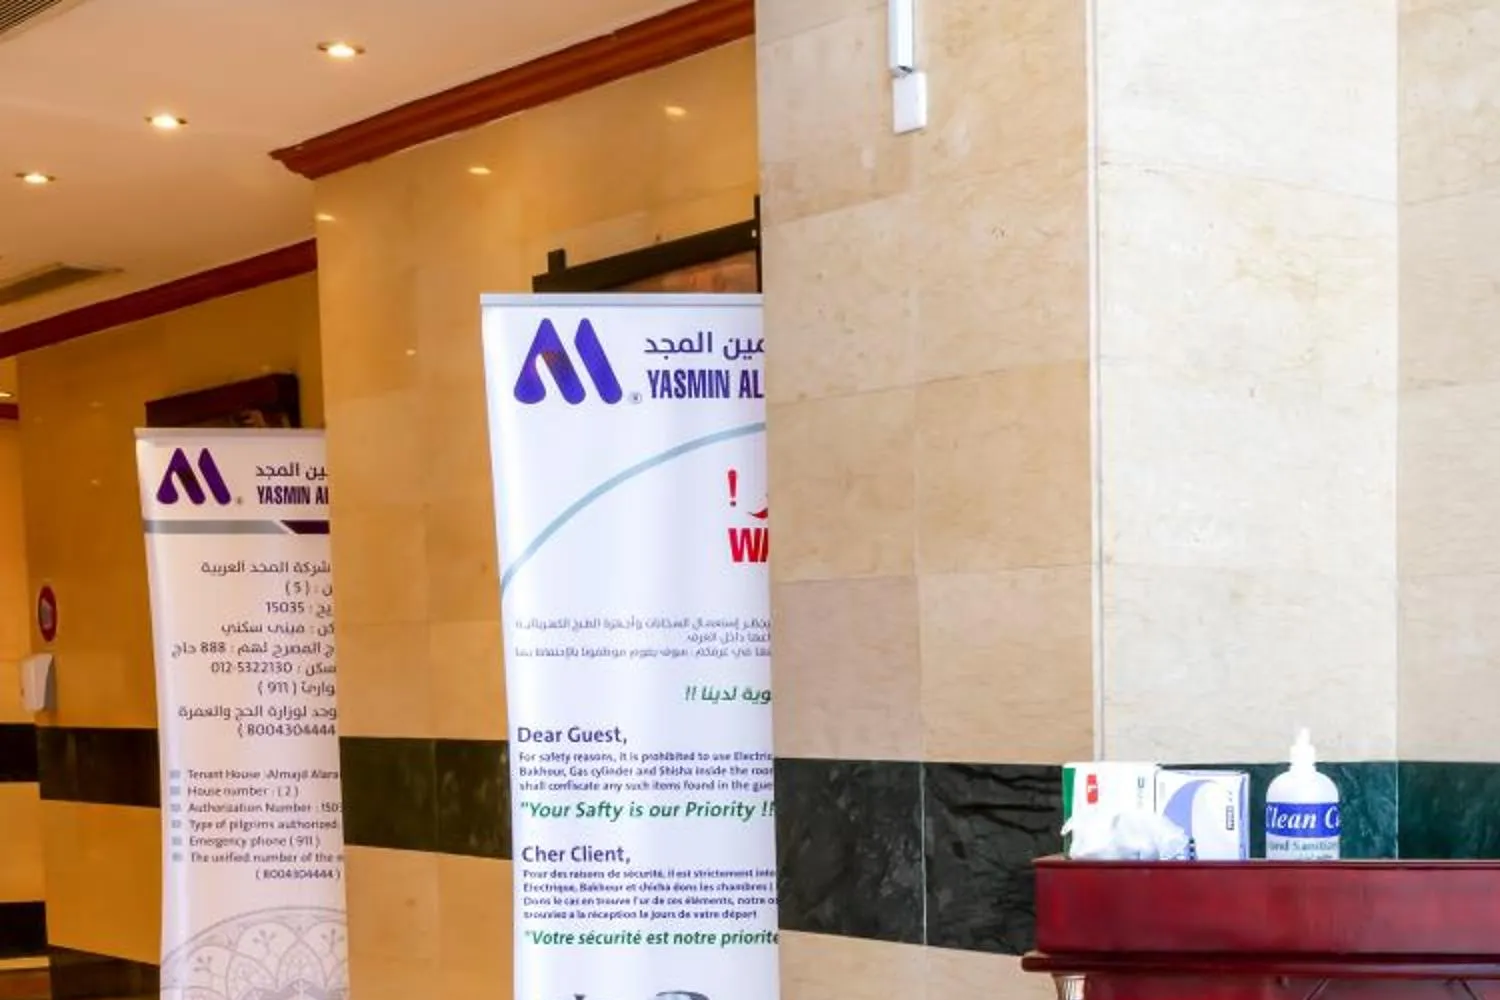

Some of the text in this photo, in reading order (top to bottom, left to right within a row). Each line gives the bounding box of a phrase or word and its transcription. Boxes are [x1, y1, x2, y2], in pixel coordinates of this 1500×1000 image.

[644, 331, 713, 361] المجد
[646, 369, 765, 399] YASMIN AL
[256, 462, 299, 480] المجد
[257, 485, 311, 505] YASMIN
[265, 602, 305, 614] 15035
[516, 726, 628, 745] Dear Guest,
[575, 801, 624, 822] Safty
[629, 801, 643, 817] is
[649, 804, 679, 817] our
[685, 801, 756, 822] Priority
[521, 846, 631, 865] Cher Client,
[578, 930, 642, 945] sécurité
[646, 932, 669, 945] est
[673, 932, 714, 945] notre
